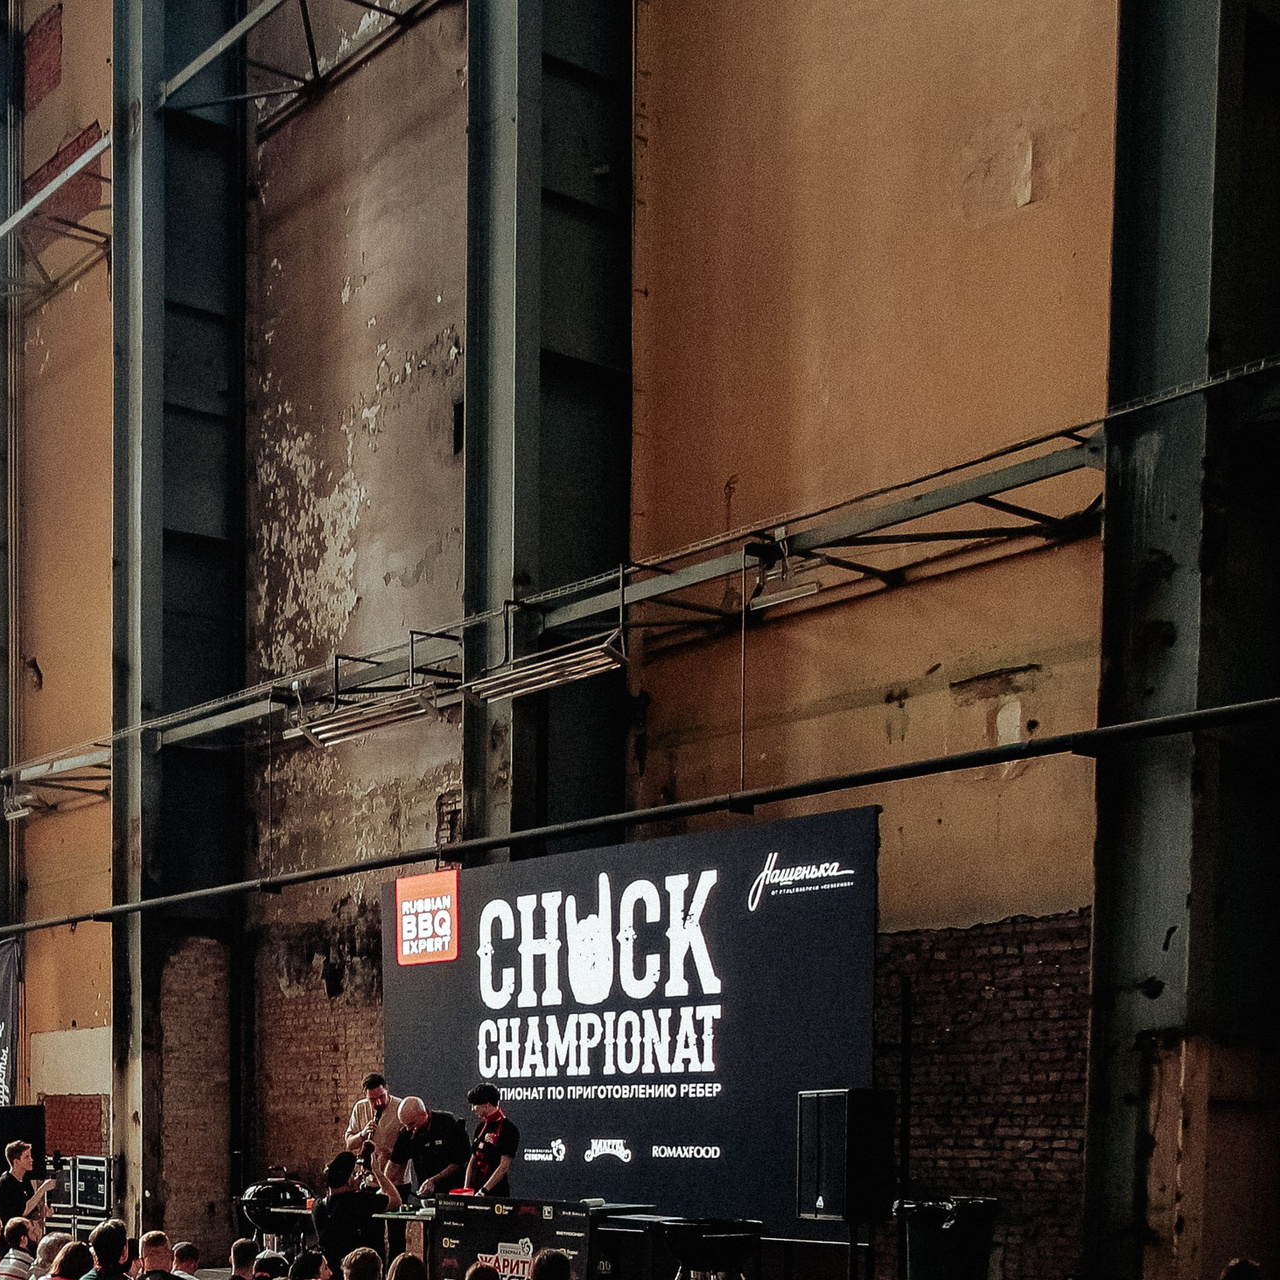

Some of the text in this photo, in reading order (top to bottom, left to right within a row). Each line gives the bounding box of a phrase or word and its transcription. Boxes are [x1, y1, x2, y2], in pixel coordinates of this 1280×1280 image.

[748, 852, 855, 912] Нашенька
[401, 895, 452, 915] RUSSIAN
[402, 909, 452, 940] BBQ
[402, 936, 452, 955] EXPERT
[477, 1005, 722, 1079] CHAMPIONAT
[497, 1083, 722, 1101] ПИОНАТ ПО ПРИГОТОВЛЕНИЮ РЕБЕР
[651, 1145, 721, 1159] ROMAXFOOD
[478, 1255, 531, 1275] АРИТ
